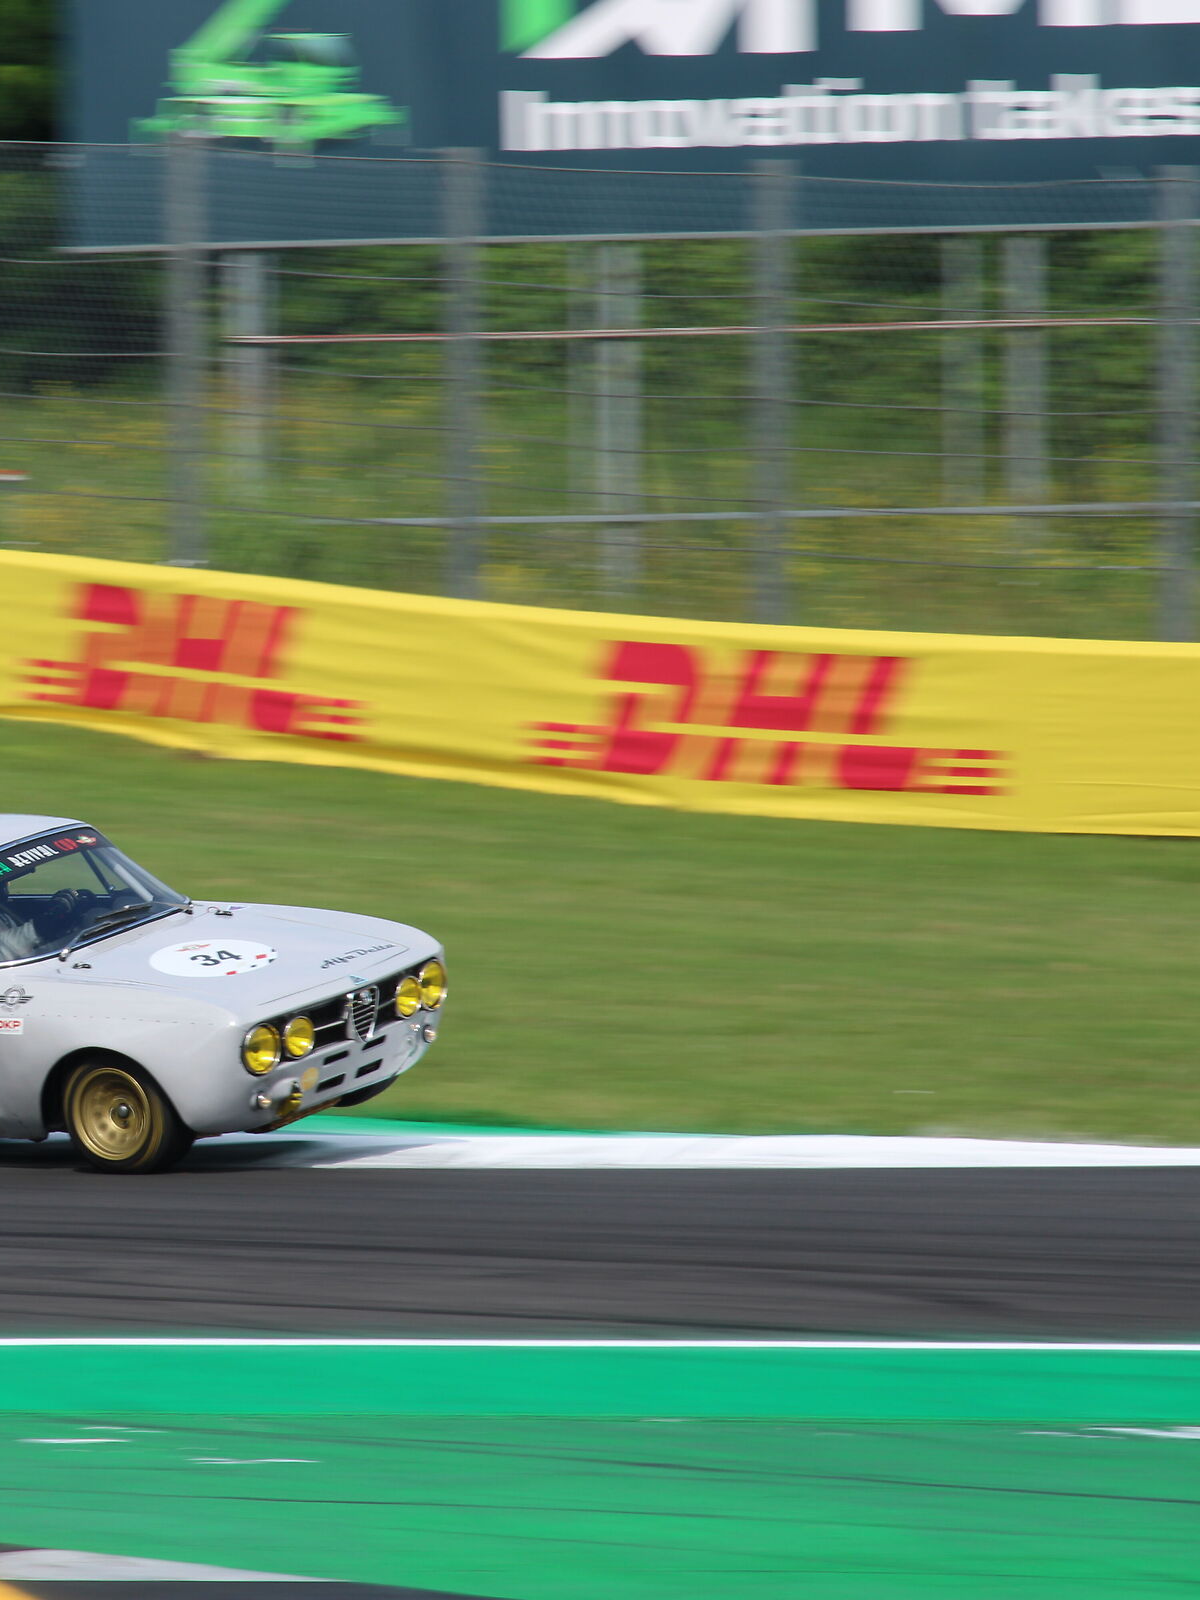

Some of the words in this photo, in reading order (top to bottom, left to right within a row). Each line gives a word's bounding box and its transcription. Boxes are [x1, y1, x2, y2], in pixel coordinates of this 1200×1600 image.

[70, 583, 307, 733] DHL
[593, 640, 925, 791] DHL
[190, 949, 243, 967] 34
